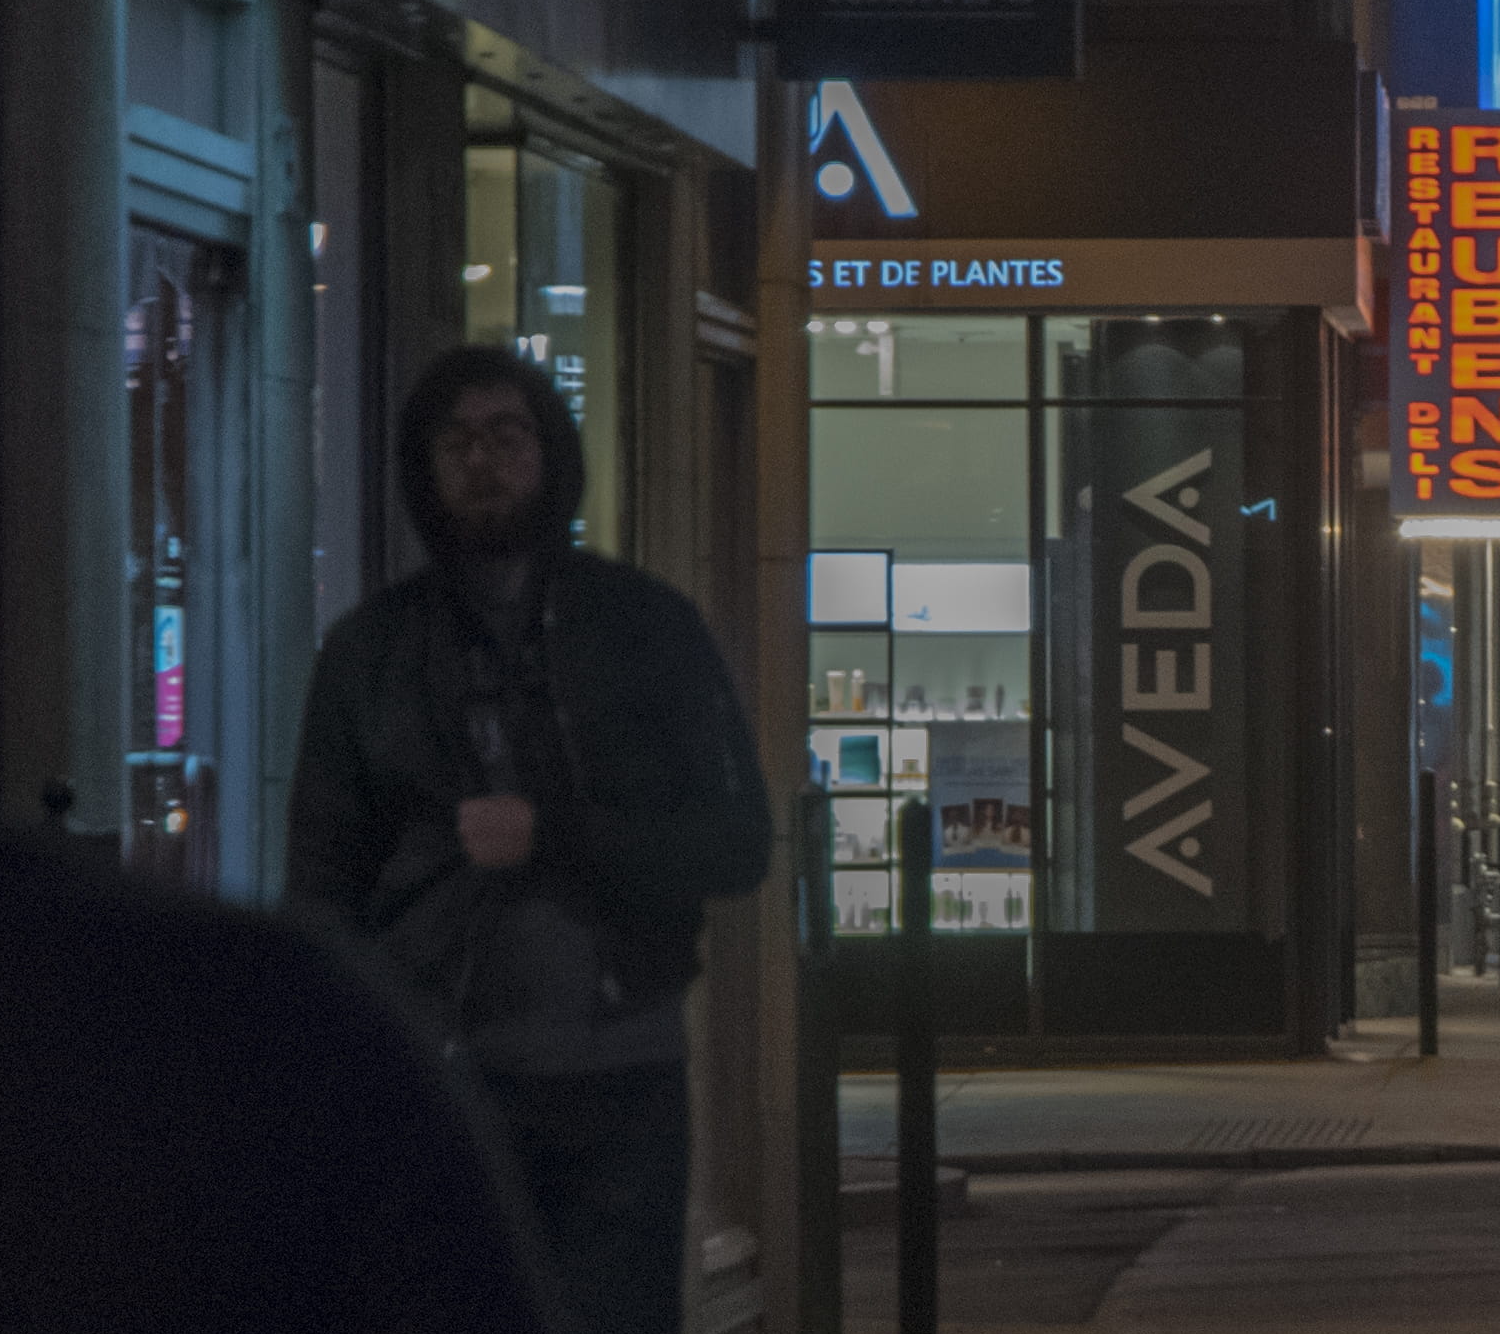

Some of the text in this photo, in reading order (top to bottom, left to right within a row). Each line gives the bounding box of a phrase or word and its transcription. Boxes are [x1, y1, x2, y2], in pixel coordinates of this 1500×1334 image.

[833, 260, 872, 287] ET
[881, 260, 921, 287] DE
[931, 259, 1065, 288] PLANTES
[1407, 127, 1441, 500] RESTAURANT DELI
[1121, 448, 1214, 898] AVEDA
